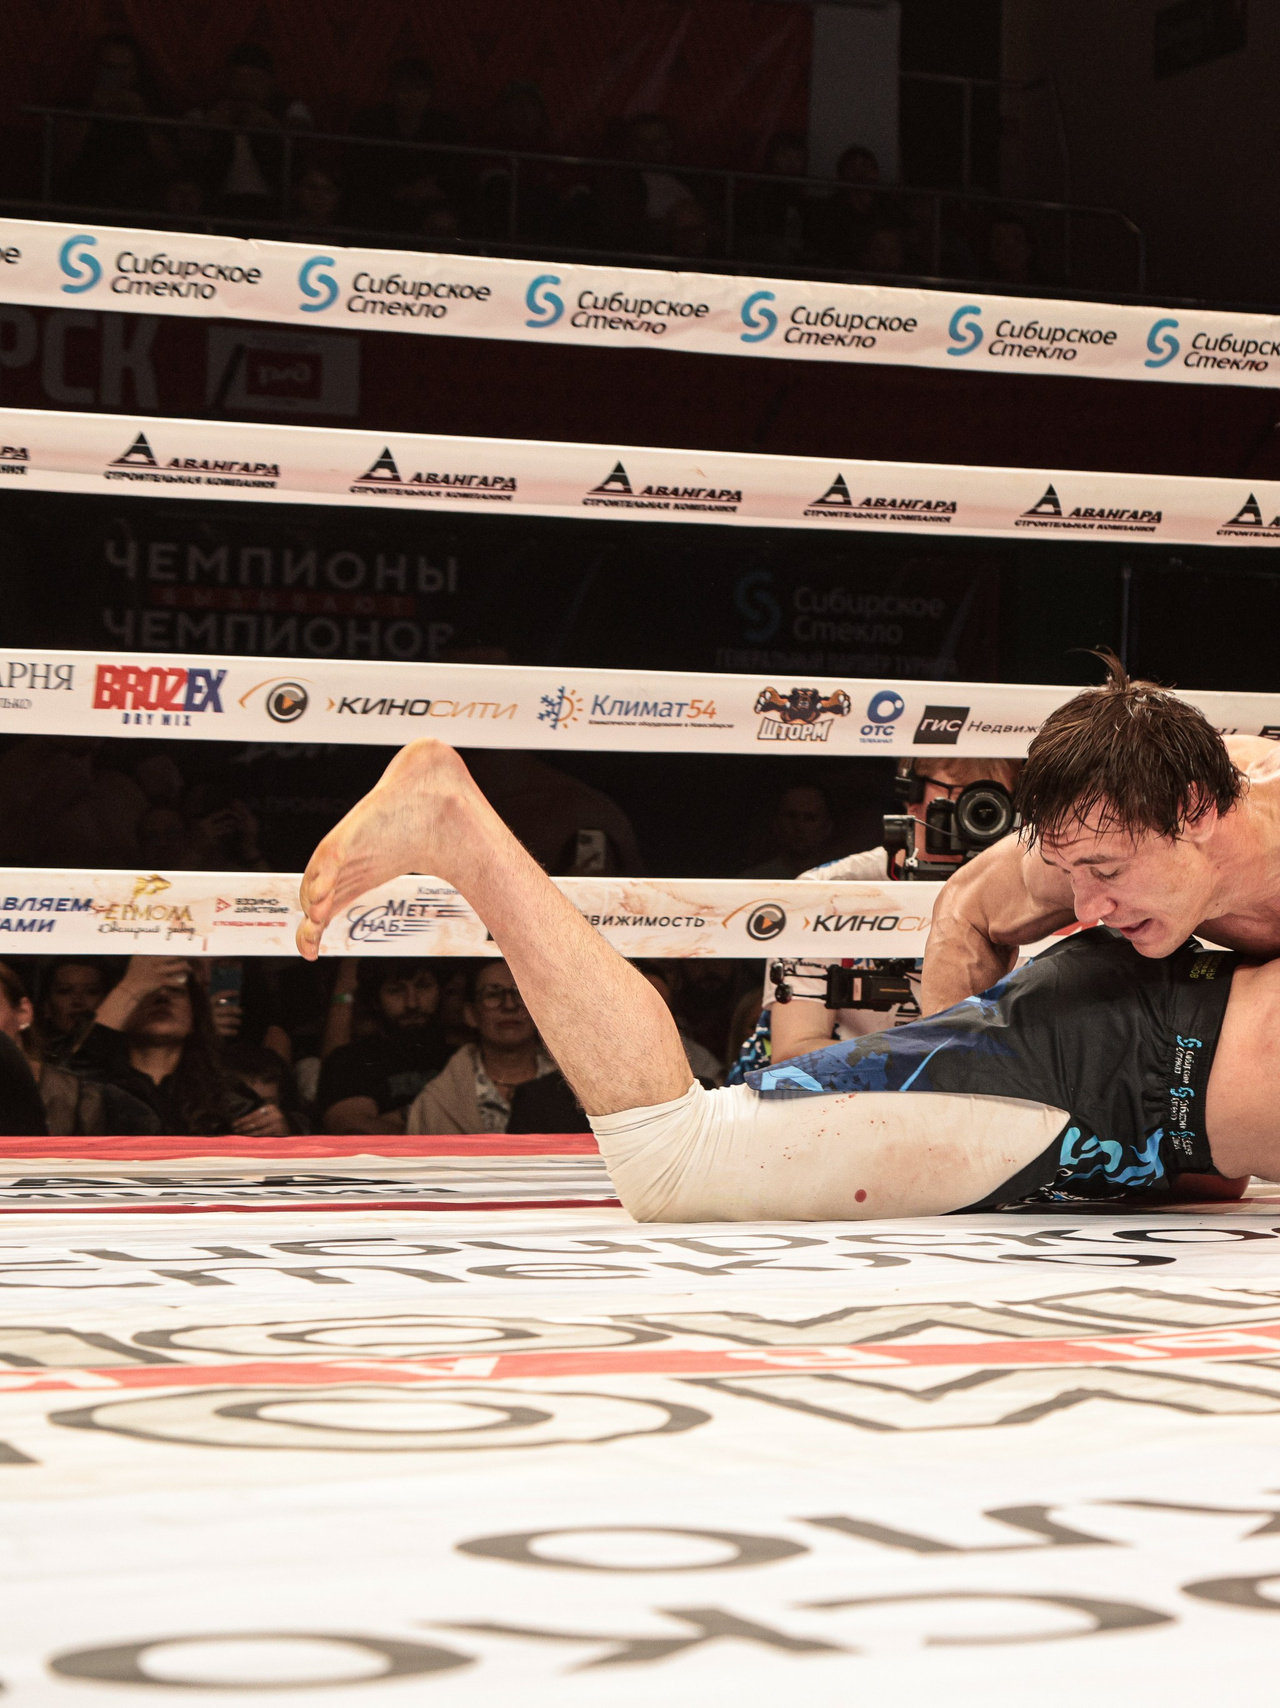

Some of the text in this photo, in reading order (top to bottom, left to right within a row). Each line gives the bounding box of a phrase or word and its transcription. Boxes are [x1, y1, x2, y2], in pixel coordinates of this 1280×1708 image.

[116, 251, 262, 284] Сибирское
[111, 276, 216, 300] Стекло
[353, 272, 492, 303] Сибирское
[347, 296, 447, 319] Стекло
[577, 290, 709, 320] Сибирское
[570, 312, 667, 335] Стекло
[790, 306, 917, 334] Сибирское
[783, 326, 876, 349] Стекло
[994, 319, 1117, 347] Сибирское
[988, 339, 1077, 362] Стекло
[1183, 351, 1268, 372] Стекло
[169, 457, 280, 477] АВАНГАРД
[410, 472, 517, 491] АВАНГАРД
[642, 485, 743, 503] АВАНГАРД
[859, 497, 957, 514] АВАНГАРД
[1069, 506, 1162, 524] АВАНГАРД
[104, 539, 459, 593] ЧЕМПИОНЫ
[793, 586, 945, 619] Сибирское
[793, 615, 903, 645] Стекло
[92, 664, 228, 712] BROZEX
[337, 696, 518, 720] КИНОСИТИ
[591, 694, 717, 719] Климат54
[122, 713, 192, 726] DRY MIX
[757, 717, 834, 742] ШТОРМ
[860, 725, 895, 737] ОТС
[919, 718, 1042, 735] ГИС Недвиж
[813, 915, 932, 932] КИНОСИ
